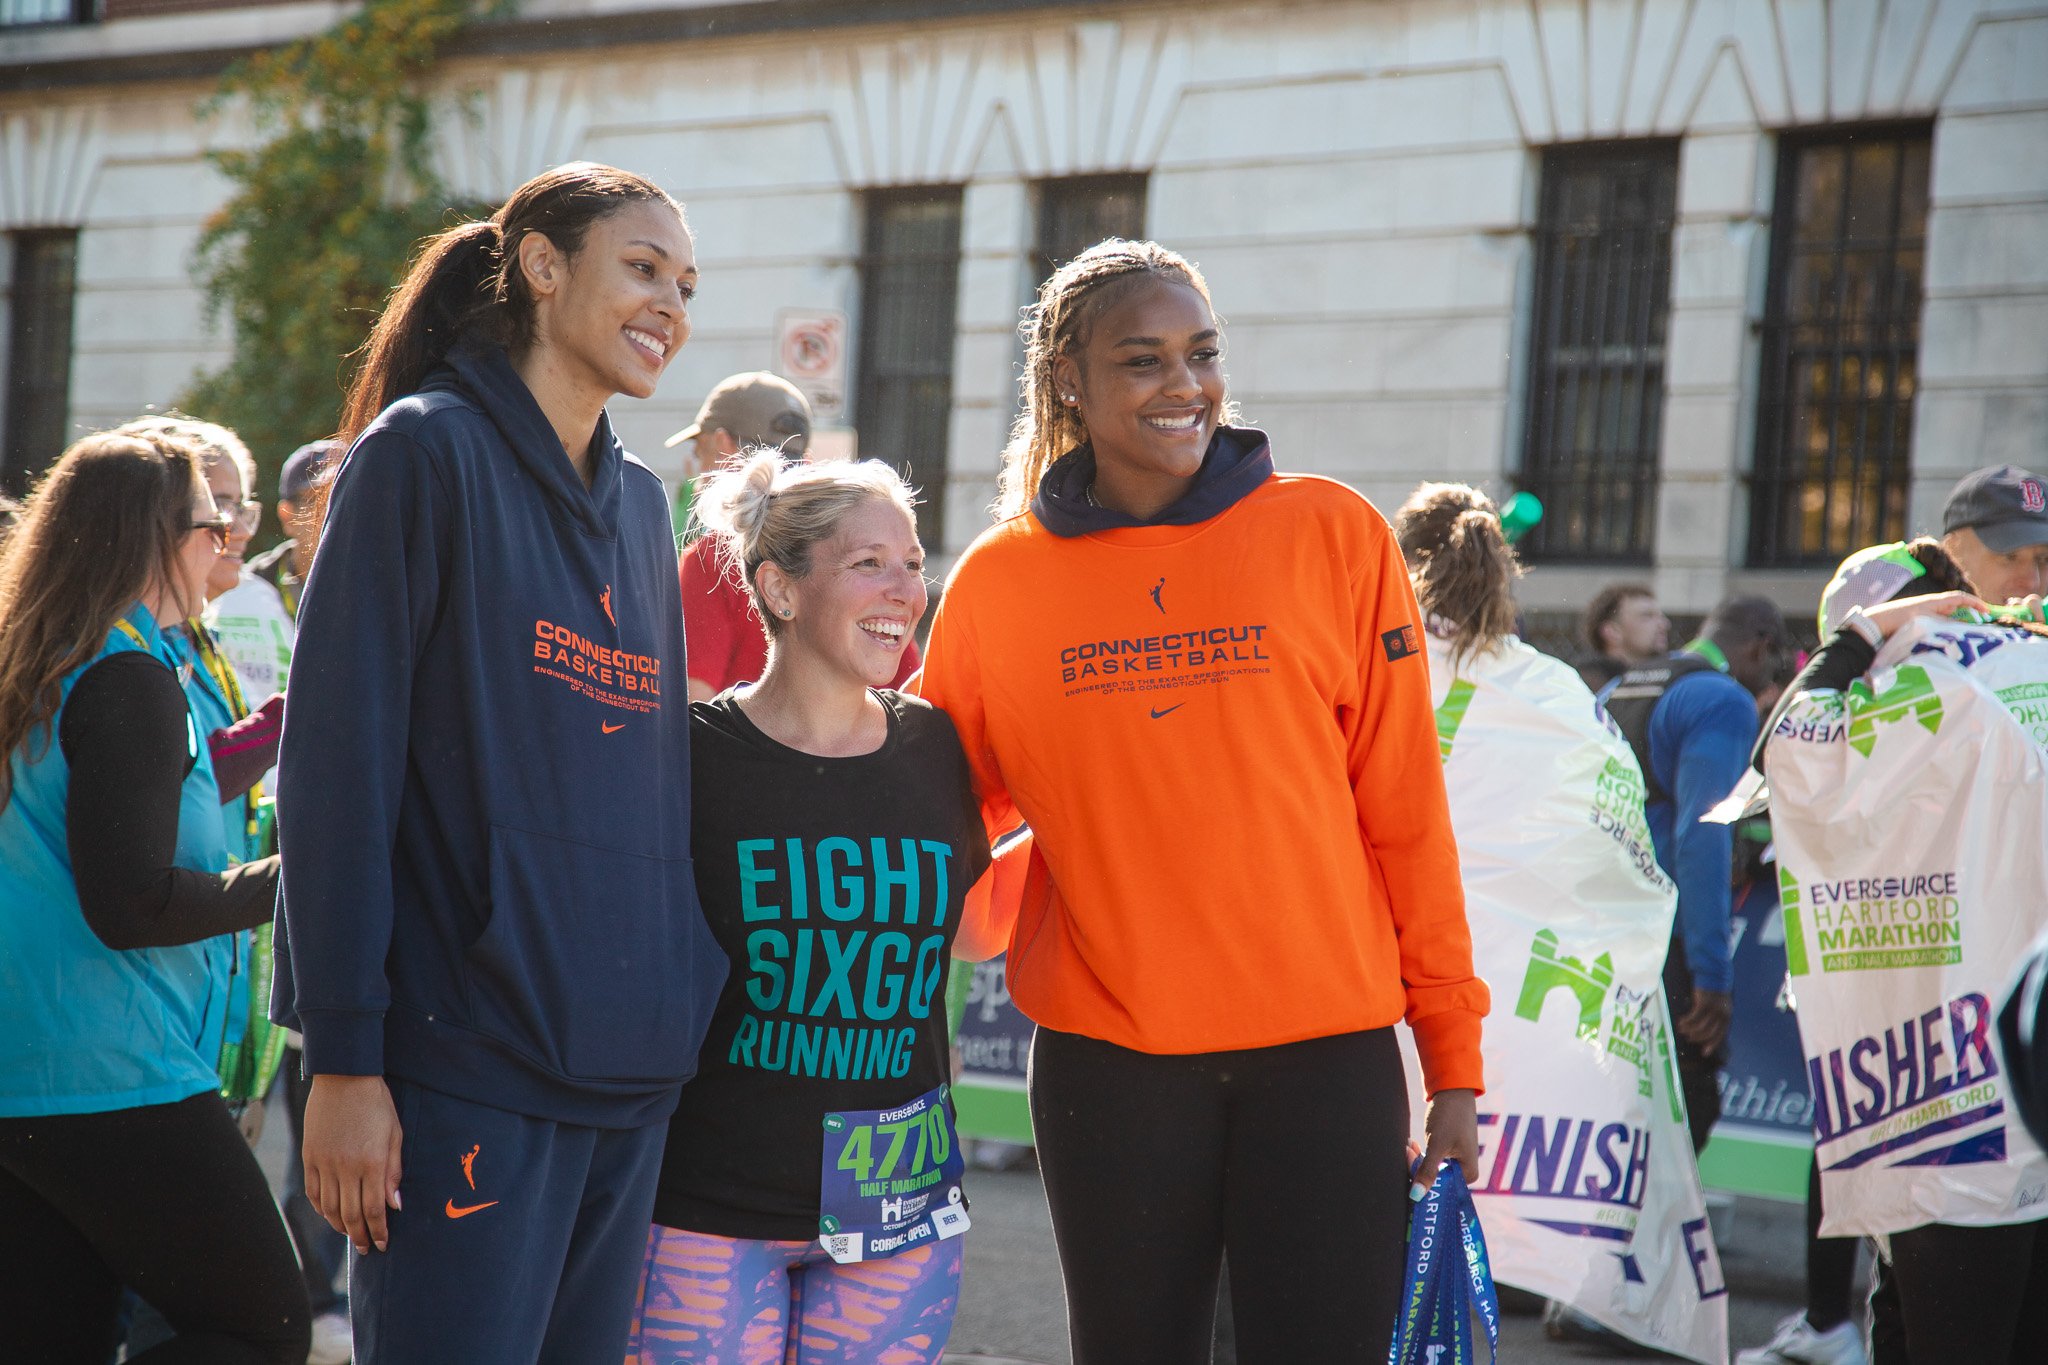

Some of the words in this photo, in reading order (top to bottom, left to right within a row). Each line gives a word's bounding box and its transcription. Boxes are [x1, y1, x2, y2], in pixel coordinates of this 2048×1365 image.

[2019, 480, 2046, 512] B
[1060, 625, 1267, 664] CONNECTICUT
[534, 641, 660, 696] BASKETBALL
[1062, 645, 1269, 683] BASKETBALL
[534, 666, 583, 687] ENGINEERED
[585, 684, 594, 692] TO
[595, 688, 607, 698] THE
[608, 694, 628, 703] EXACT
[1065, 681, 1119, 697] ENGINEERED
[1137, 678, 1155, 686] THE
[1159, 674, 1190, 683] EXACT
[1193, 667, 1271, 681] SPECIFICATIONS
[1138, 679, 1208, 691] CONNECTICUT
[1210, 676, 1230, 684] SUN
[582, 688, 595, 699] THE
[596, 694, 638, 711] CONNECTICUT
[737, 836, 953, 927] EIGHT
[1811, 872, 1959, 905] EVERSOURCE
[1814, 897, 1959, 928] HARTFORD
[1818, 920, 1961, 951] MARATHON
[746, 928, 945, 1021] SIXGO
[1827, 954, 1858, 970] AND
[728, 1013, 916, 1081] RUNNING
[879, 1099, 927, 1123] EVERSOURCE
[837, 1103, 950, 1181] 4770
[860, 1180, 889, 1197] HALF
[891, 1167, 942, 1195] MARATHON
[942, 1213, 959, 1226] BEER
[1416, 1177, 1442, 1275] HARTFORD
[870, 1234, 907, 1253] CORRAL:
[908, 1222, 932, 1242] OPEN
